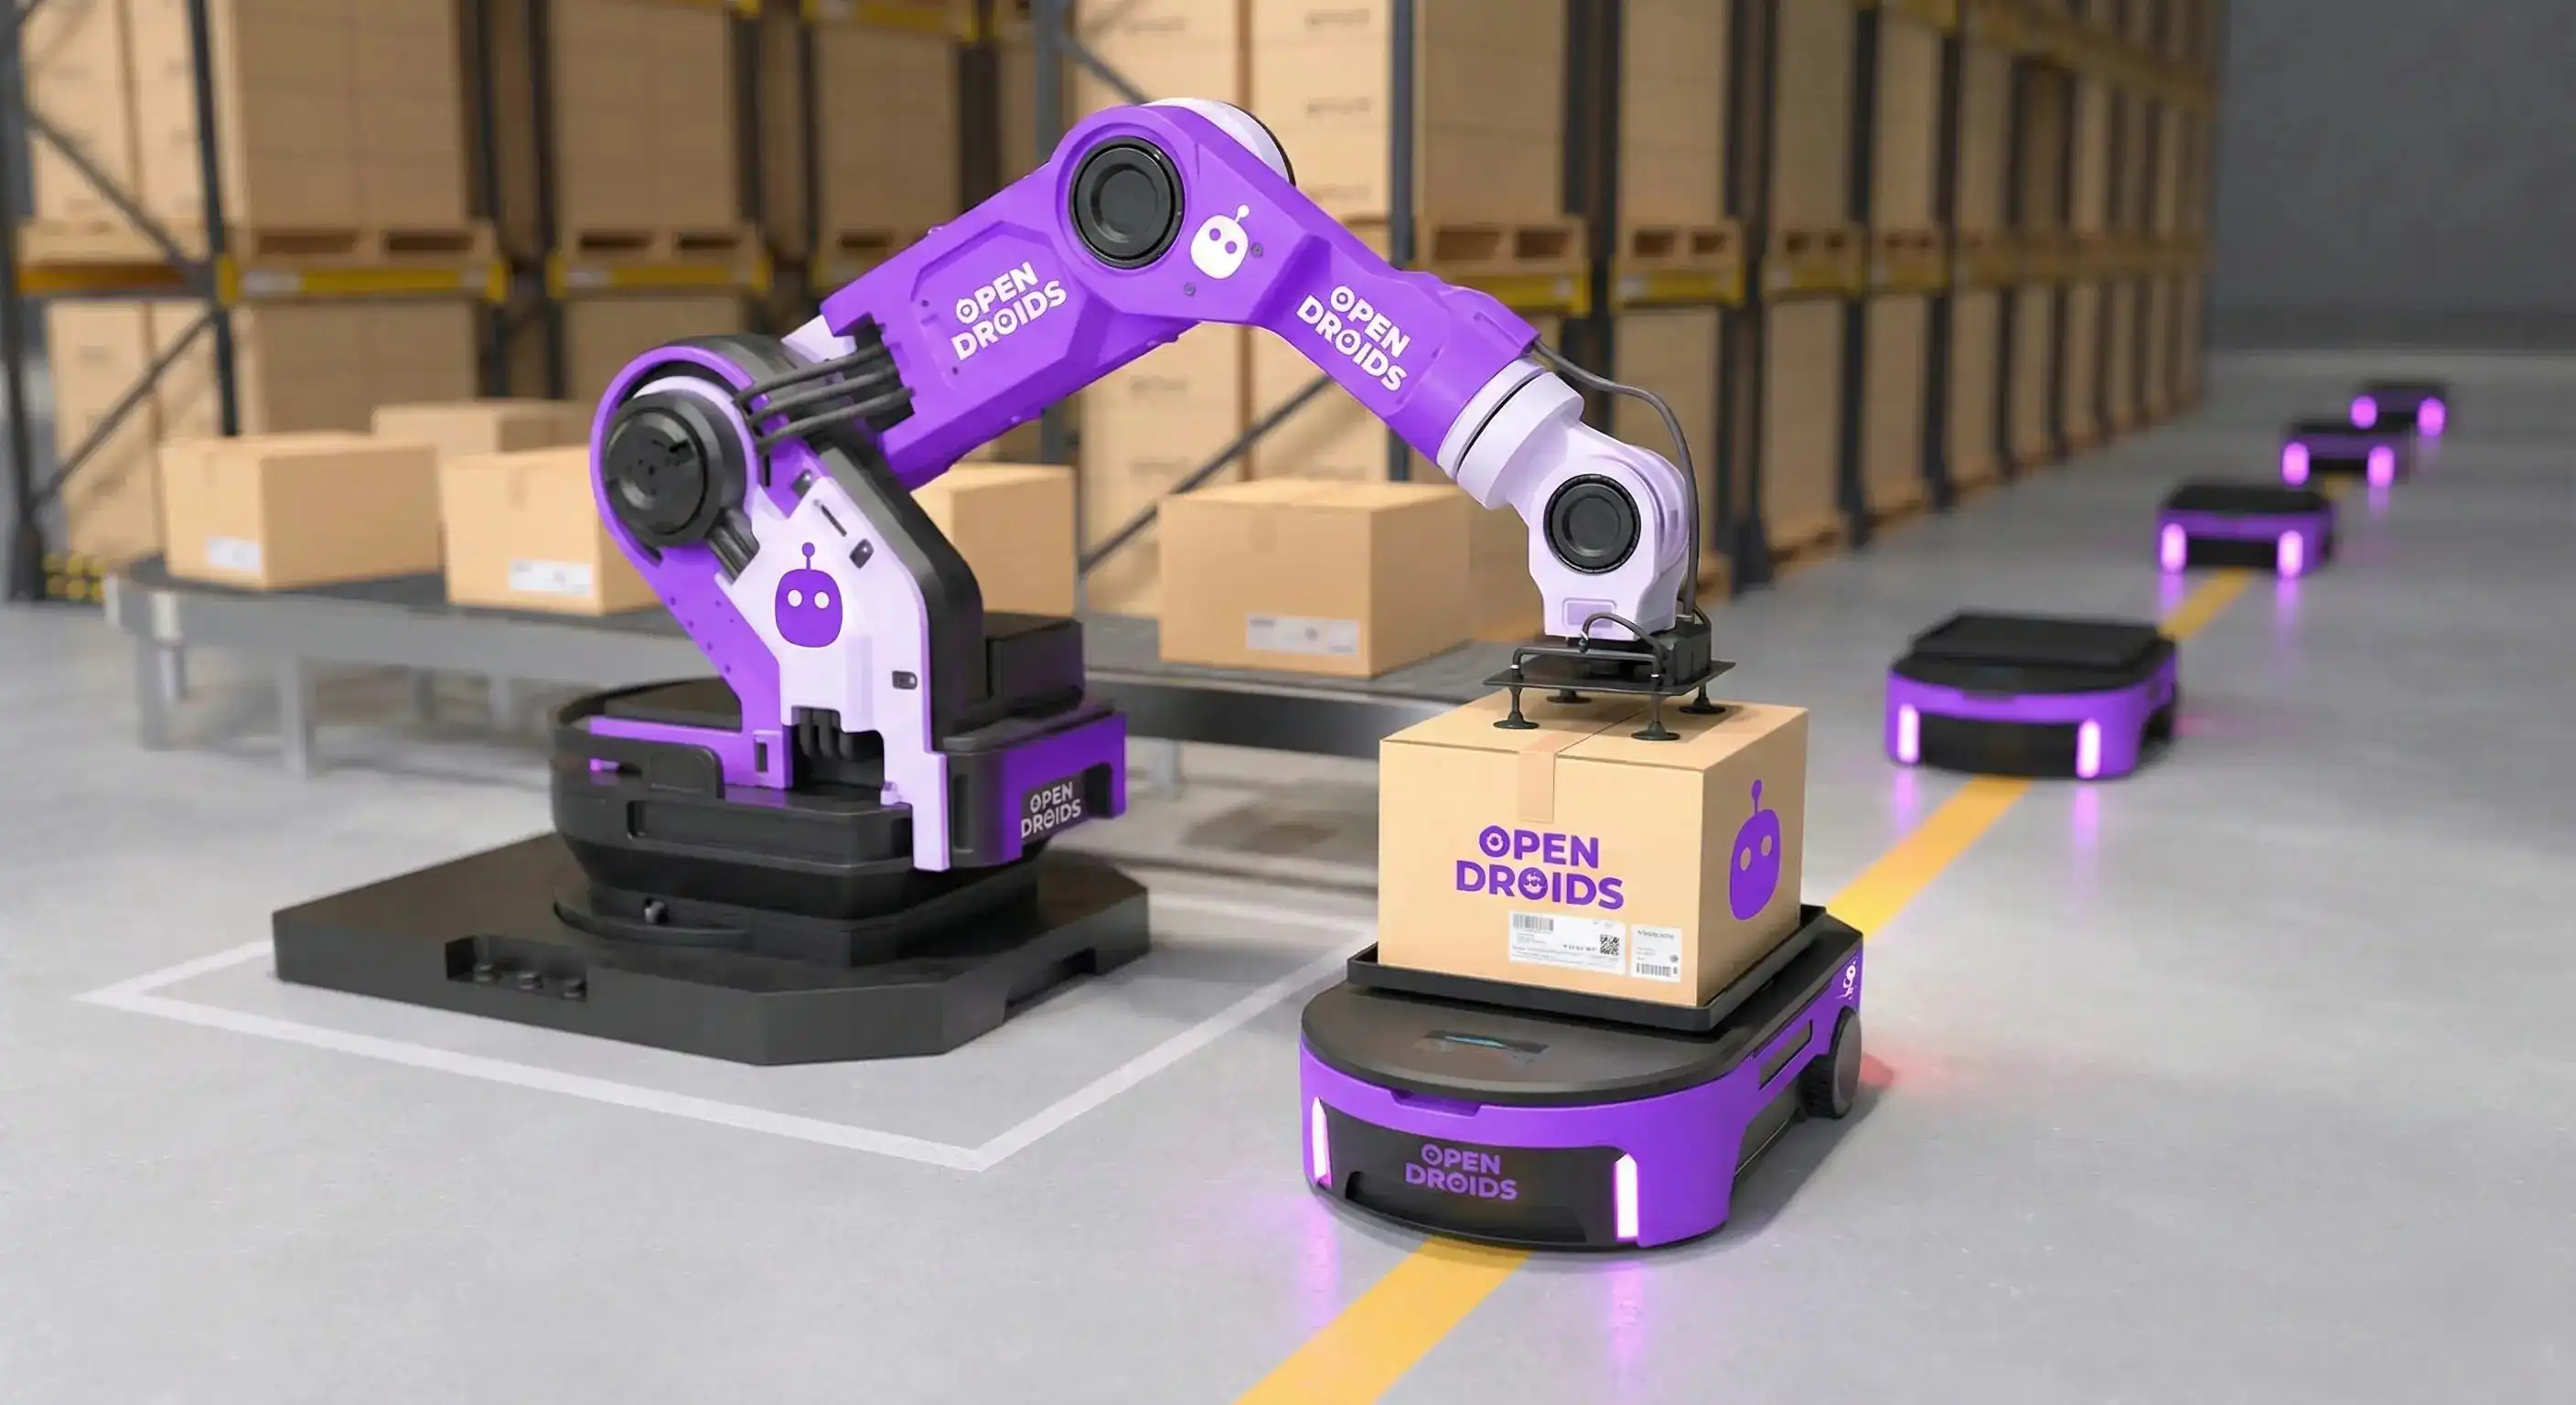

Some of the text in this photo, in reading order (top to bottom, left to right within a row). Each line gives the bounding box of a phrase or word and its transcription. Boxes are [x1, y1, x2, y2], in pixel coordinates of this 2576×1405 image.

[955, 261, 1039, 324] OPEN
[950, 280, 1067, 360] DROIDS
[1296, 295, 1408, 391] DROIDS
[1330, 285, 1411, 359] OPEN
[1021, 799, 1081, 839] DROIDS
[1030, 781, 1073, 813] OPEN
[1478, 825, 1599, 869] OPEN
[1456, 860, 1625, 910] DROIDS
[1405, 1162, 1519, 1200] DROIDS
[1421, 1143, 1501, 1175] OPEN
